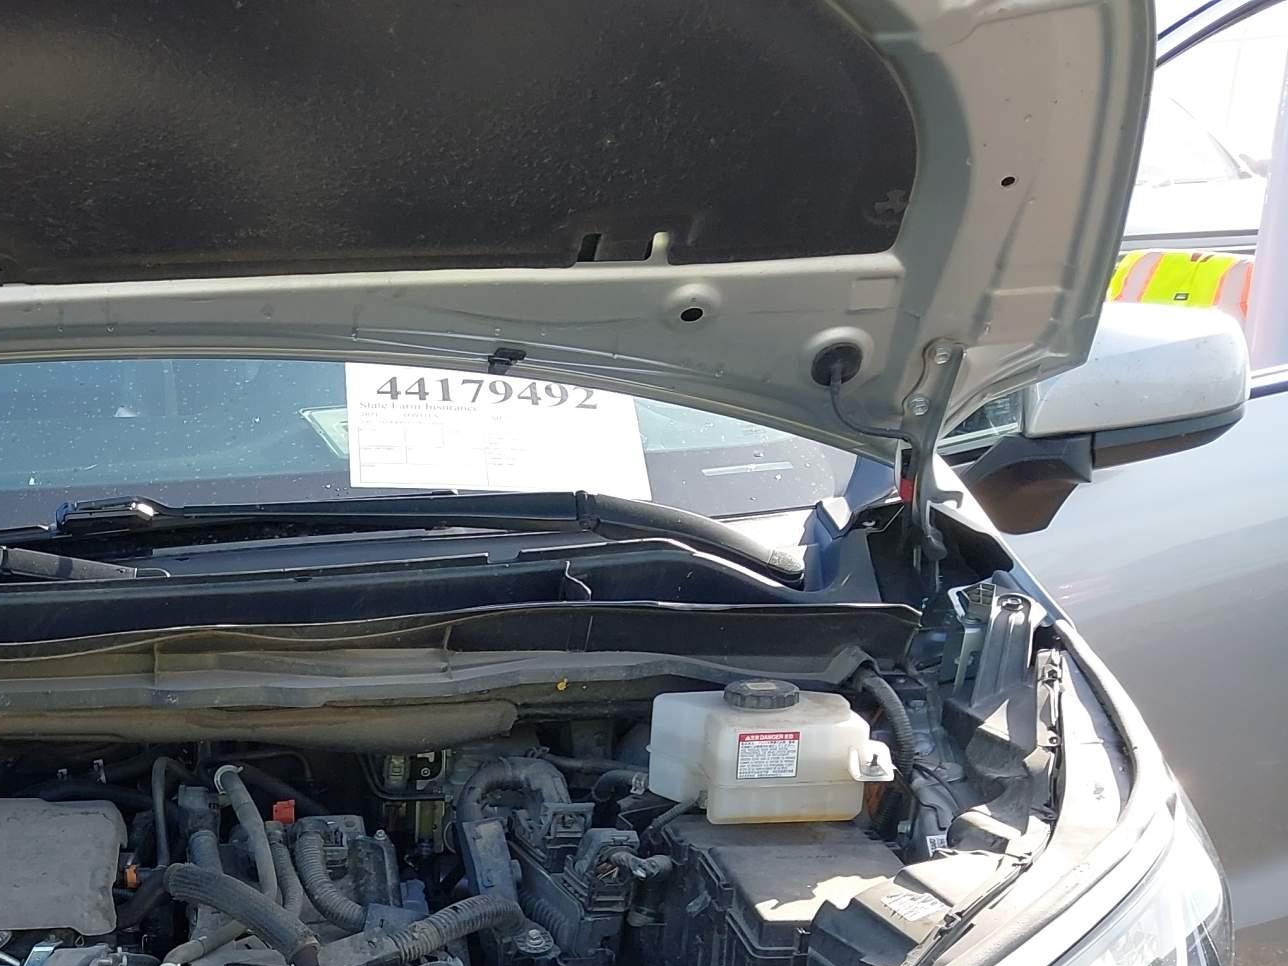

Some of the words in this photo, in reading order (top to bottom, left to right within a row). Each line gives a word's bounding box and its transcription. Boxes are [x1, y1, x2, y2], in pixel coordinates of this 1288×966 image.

[376, 376, 598, 409] 44179492
[392, 402, 421, 411] Farm
[425, 403, 478, 412] Insurance
